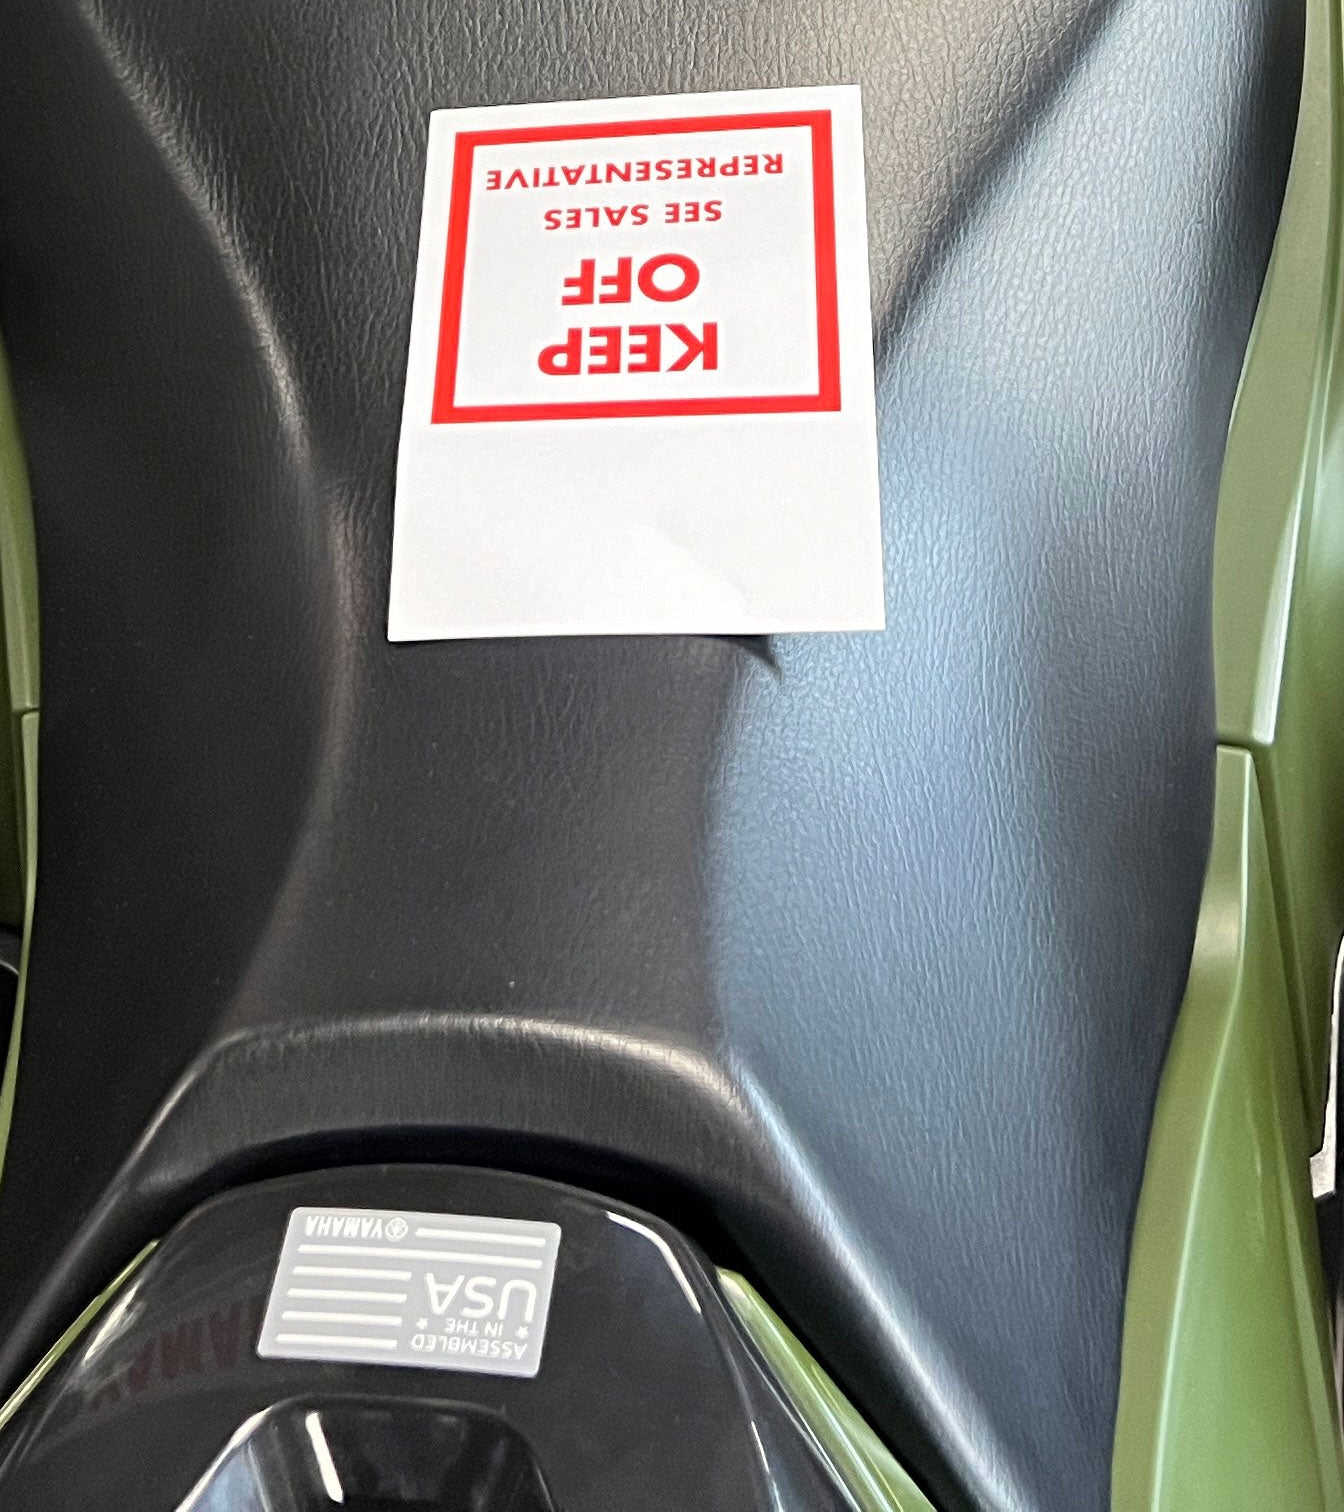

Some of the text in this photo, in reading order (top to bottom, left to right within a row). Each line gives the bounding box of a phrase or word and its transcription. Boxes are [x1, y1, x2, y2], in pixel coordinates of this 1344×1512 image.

[486, 153, 784, 190] REPRESENTATIVE
[545, 201, 722, 230] SEE SALES
[562, 254, 700, 306] OFF
[538, 322, 718, 375] KEEP
[305, 1215, 382, 1239] YAMAHA
[426, 1273, 537, 1322] USA
[446, 1318, 503, 1337] IN THE
[411, 1333, 528, 1359] ASSEMBLED
